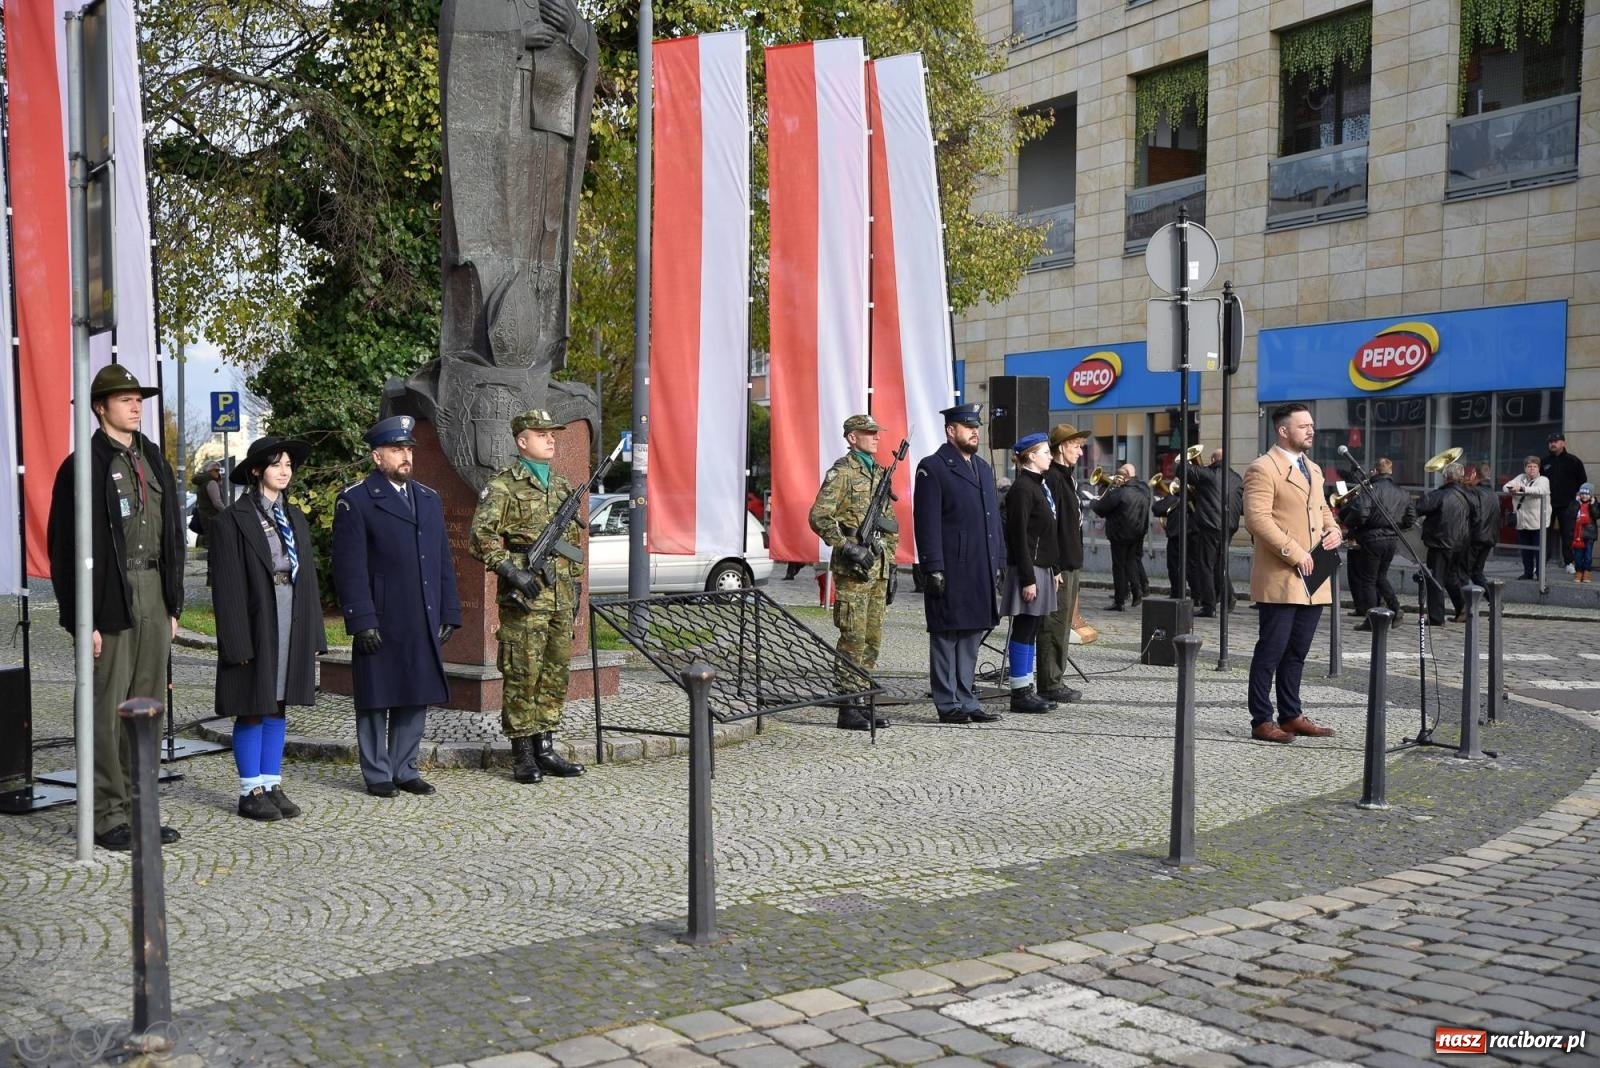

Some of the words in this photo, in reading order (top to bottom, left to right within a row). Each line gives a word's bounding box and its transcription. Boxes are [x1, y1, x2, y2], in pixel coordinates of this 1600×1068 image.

[1362, 345, 1421, 369] PEPCO
[1073, 369, 1110, 387] PEPCO
[219, 394, 233, 411] P
